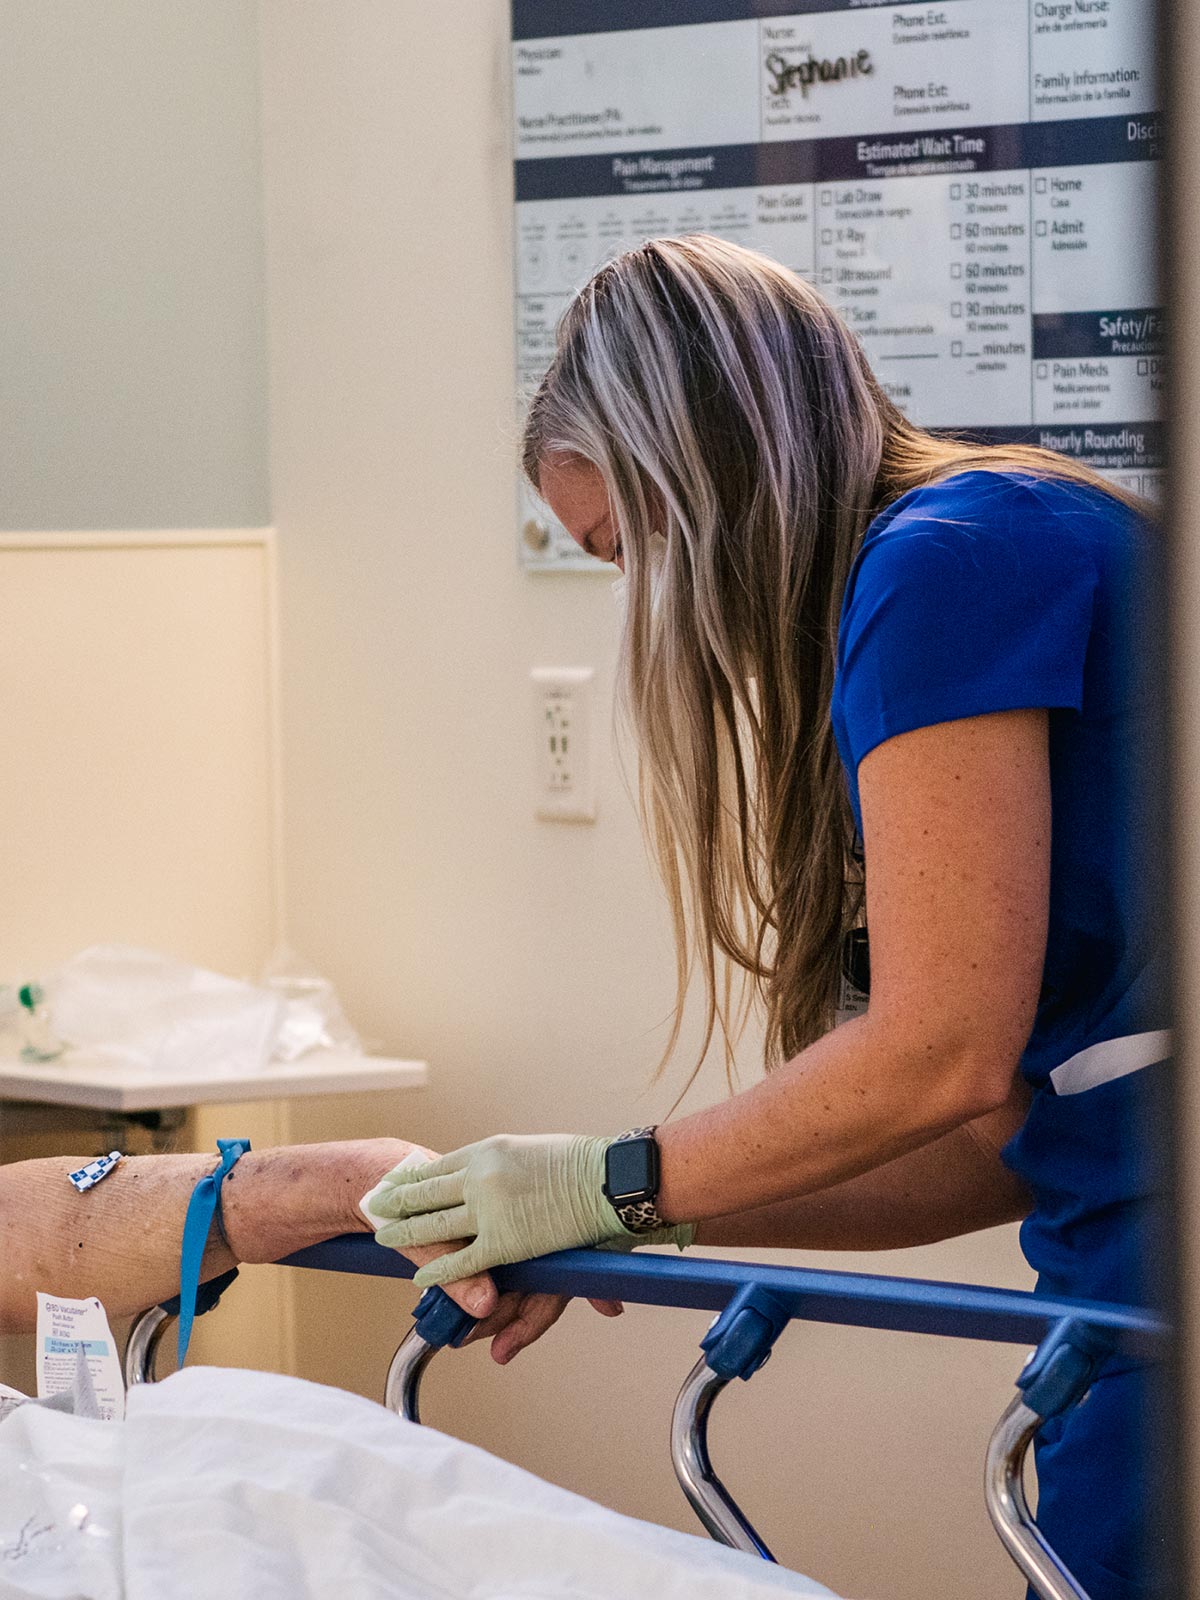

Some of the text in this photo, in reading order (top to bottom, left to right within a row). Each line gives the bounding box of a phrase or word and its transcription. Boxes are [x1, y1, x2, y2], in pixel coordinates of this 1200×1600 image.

[1034, 2, 1072, 20] Charge
[893, 13, 925, 28] Phone
[765, 48, 875, 100] Stephanie
[1034, 72, 1071, 90] Family
[894, 85, 926, 100] Phone
[857, 134, 985, 161] Estimated Wait Time
[613, 155, 715, 178] Pain Management
[965, 182, 1025, 199] 30 minutes
[1050, 177, 1082, 192] Home
[856, 188, 882, 203] Draw
[981, 221, 1025, 237] minutes
[1051, 219, 1085, 235] Admit
[981, 261, 1025, 277] minutes
[966, 301, 1026, 317] 90 minutes
[983, 340, 1026, 355] minutes
[1053, 361, 1109, 378] Pain Meds
[1040, 428, 1145, 454] Hourly Rounding
